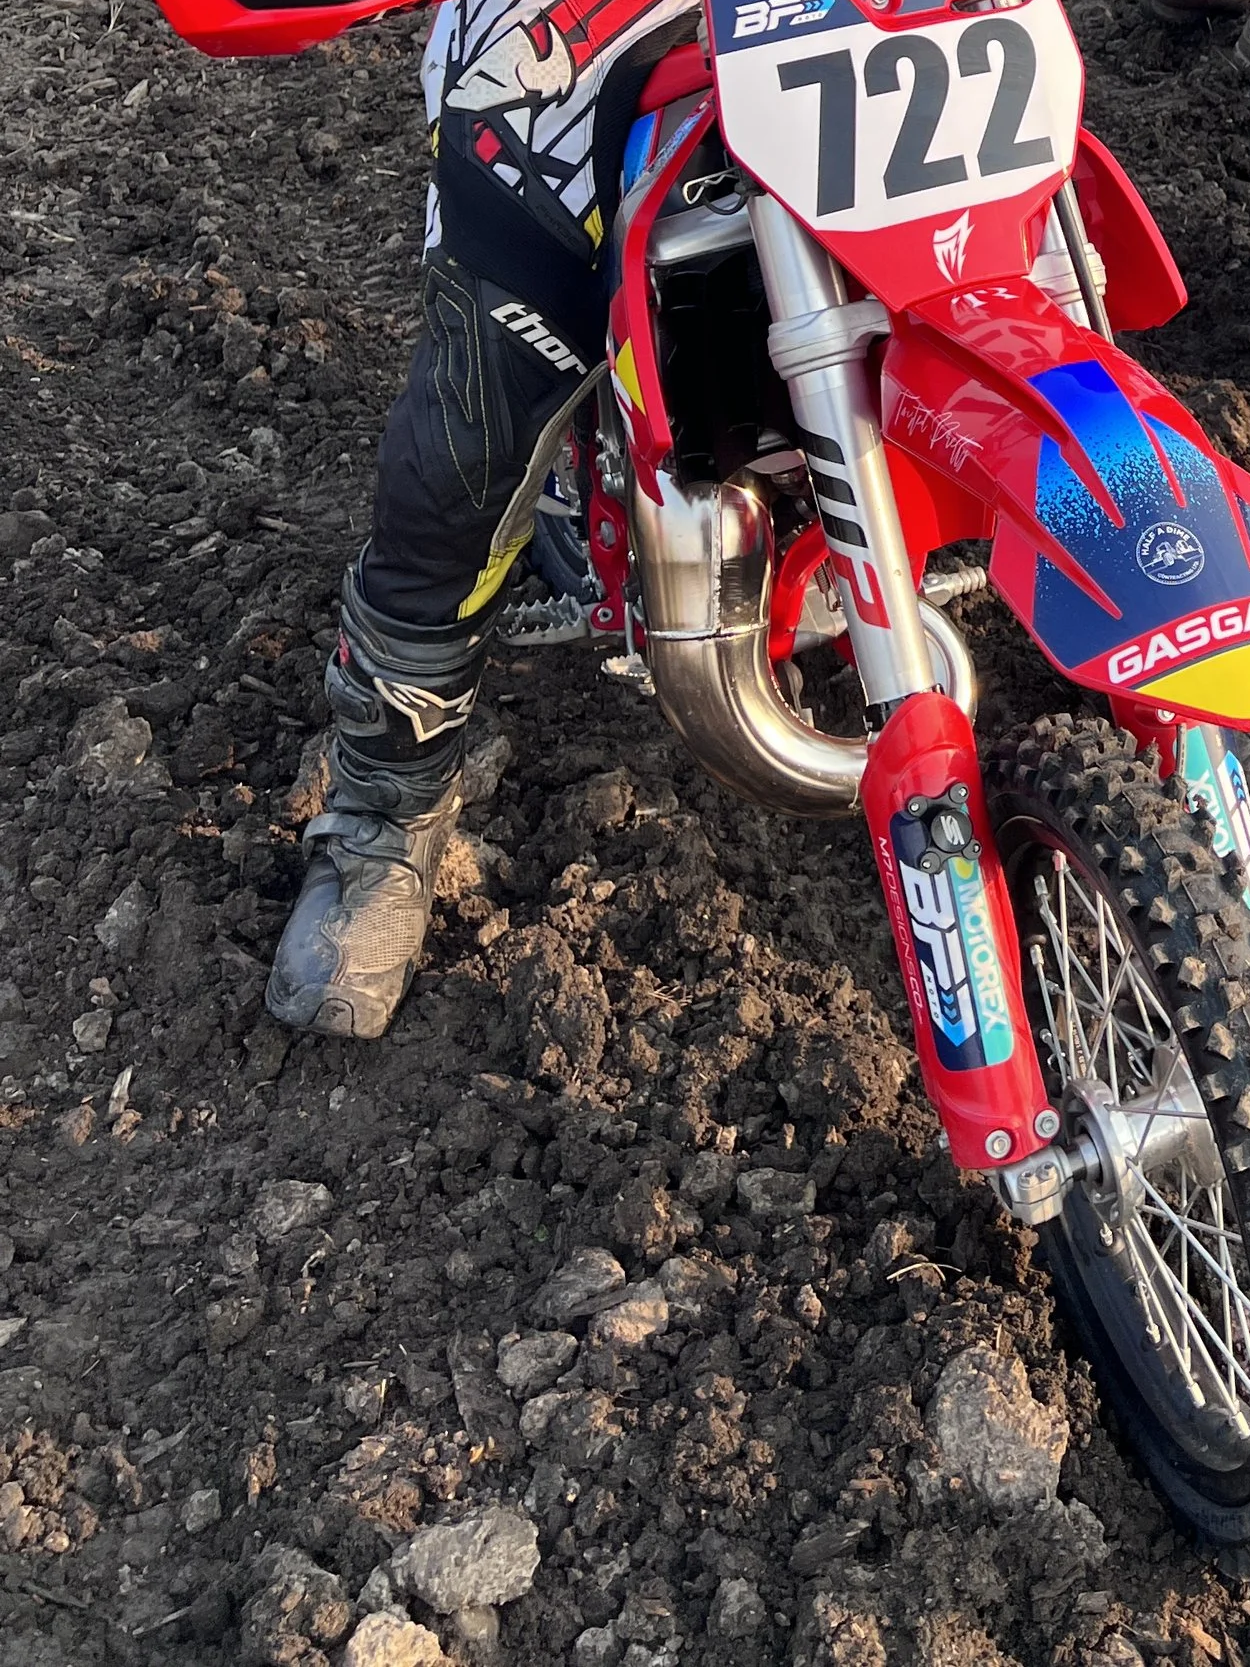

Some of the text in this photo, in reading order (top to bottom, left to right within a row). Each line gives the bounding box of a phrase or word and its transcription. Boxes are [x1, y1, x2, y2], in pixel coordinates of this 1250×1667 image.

[777, 19, 1054, 217] 722
[490, 302, 588, 375] thor
[1141, 526, 1190, 556] HALF A DIME
[957, 880, 1010, 1034] MOTOREX
